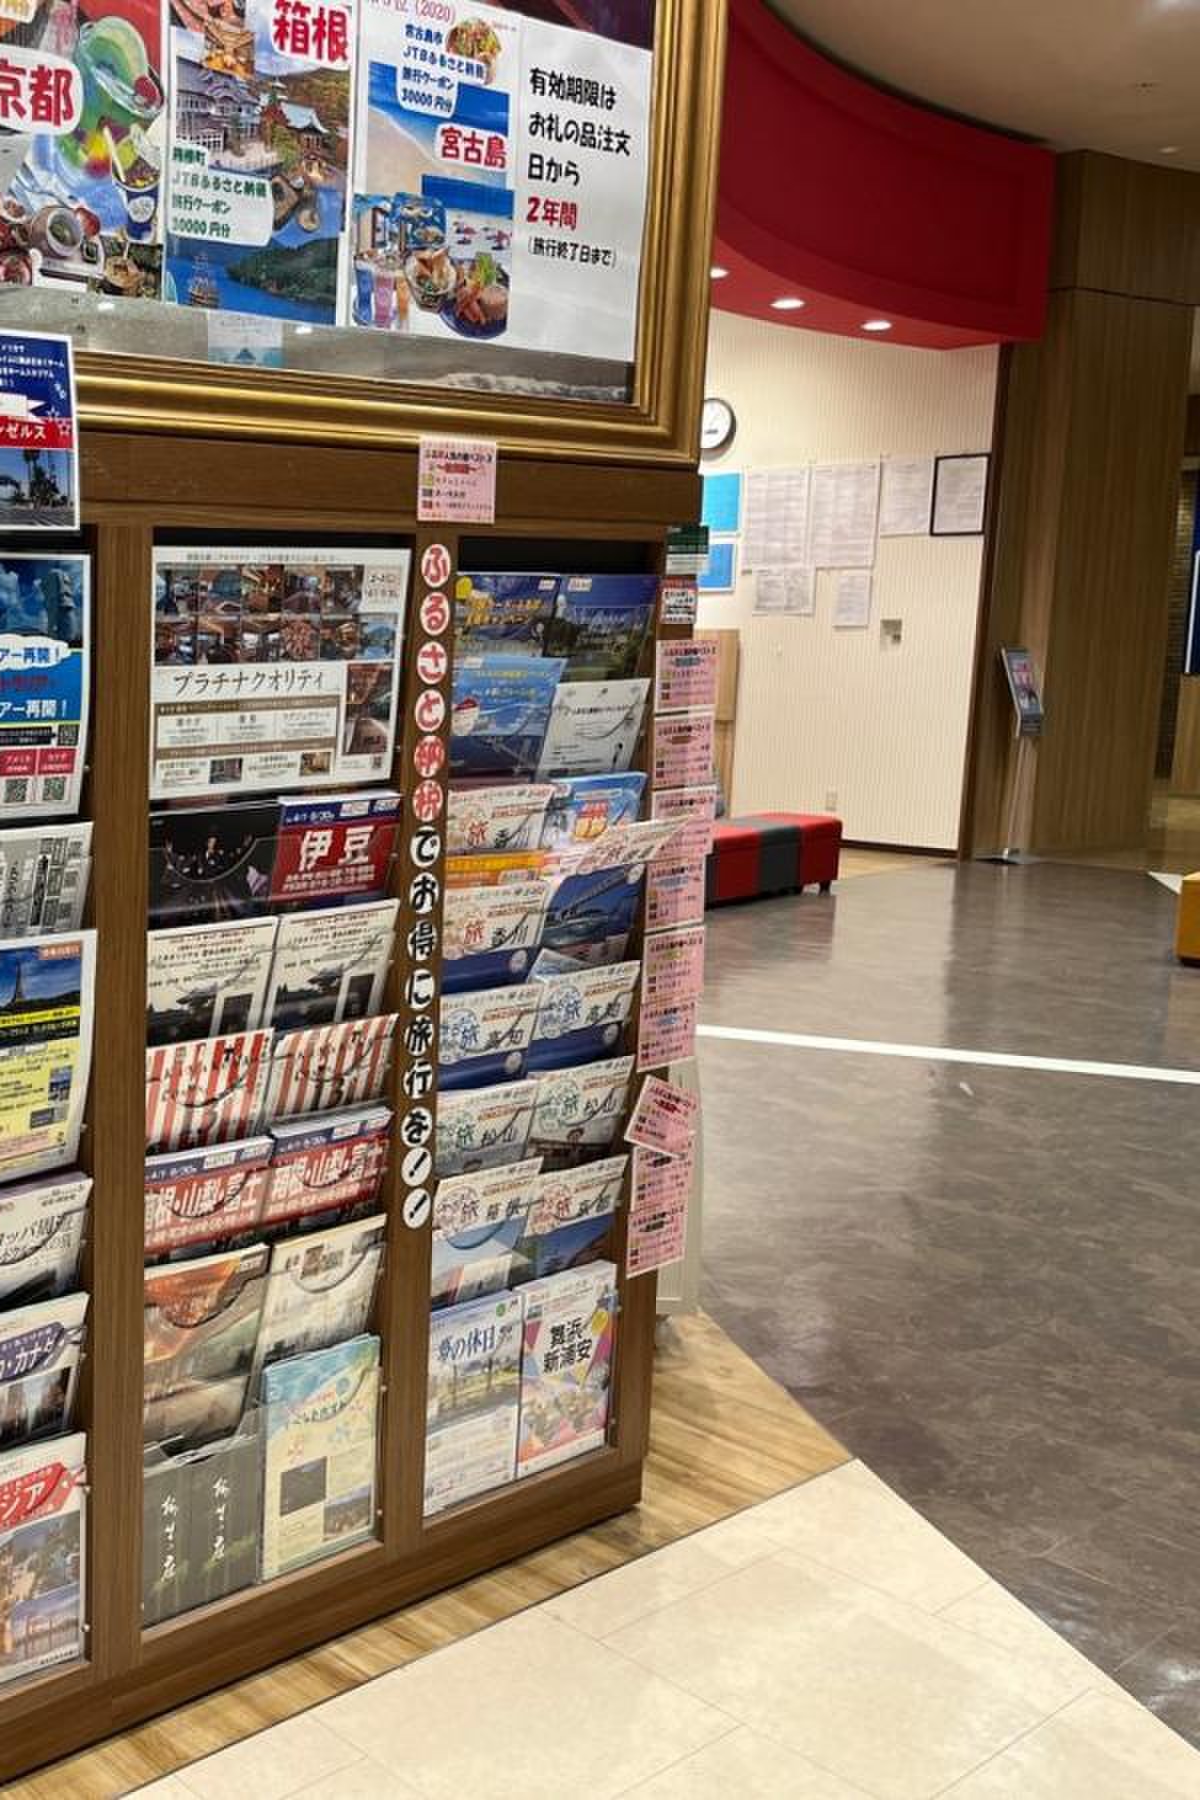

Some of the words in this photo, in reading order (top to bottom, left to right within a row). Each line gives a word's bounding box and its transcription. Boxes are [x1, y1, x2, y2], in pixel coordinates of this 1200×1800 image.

[271, 0, 348, 62] 箱根
[529, 66, 617, 111] 有効期限は
[440, 126, 507, 169] 宮古島
[528, 111, 631, 156] お礼の品注文
[527, 153, 580, 186] 日から
[526, 197, 578, 231] 2年間
[174, 670, 324, 695] プラチナクオリティ
[300, 825, 375, 872] 伊豆
